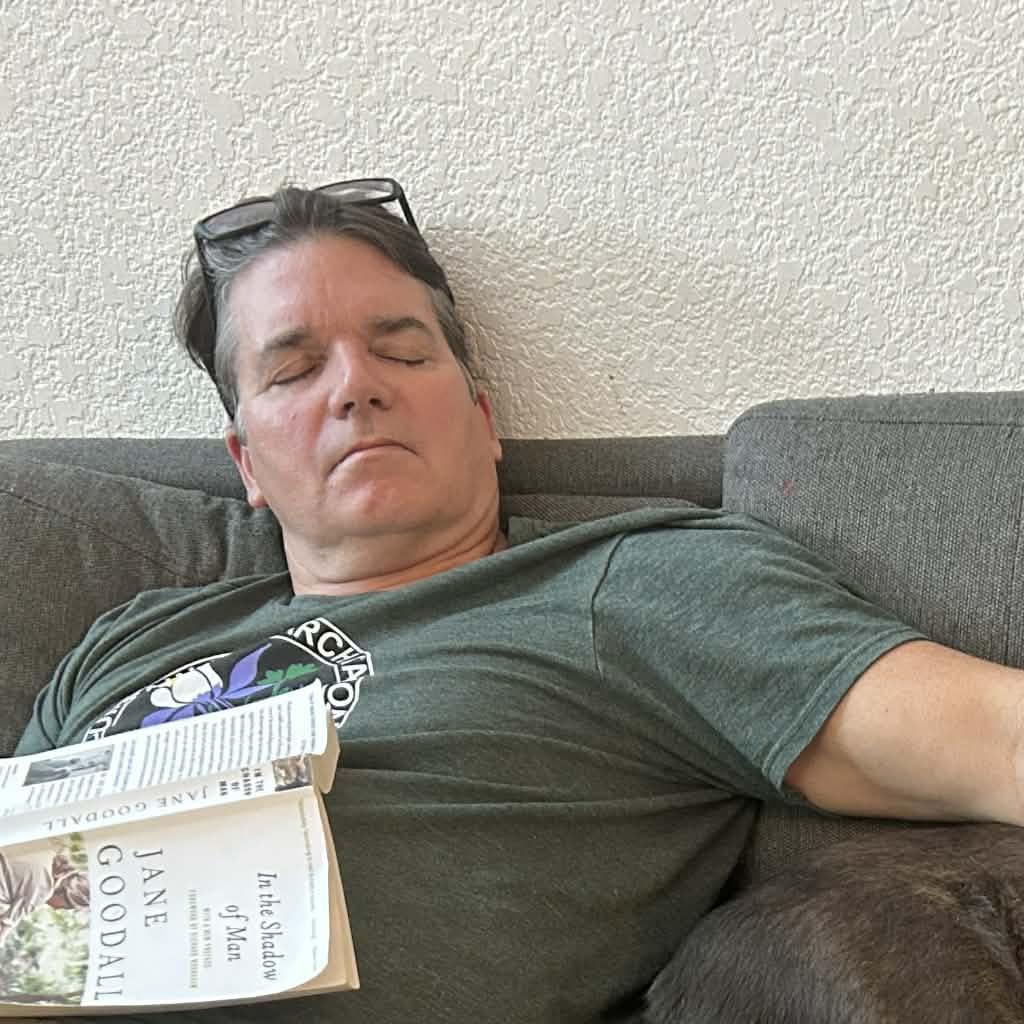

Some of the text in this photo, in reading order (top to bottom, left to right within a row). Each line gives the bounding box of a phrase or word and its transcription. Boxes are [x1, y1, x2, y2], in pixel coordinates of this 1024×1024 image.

[42, 803, 147, 831] GOODALL
[159, 785, 208, 808] JANE
[133, 848, 168, 927] JANE
[94, 844, 127, 1000] GOODALL
[218, 904, 249, 961] of Man
[257, 872, 285, 980] In the Shadow
